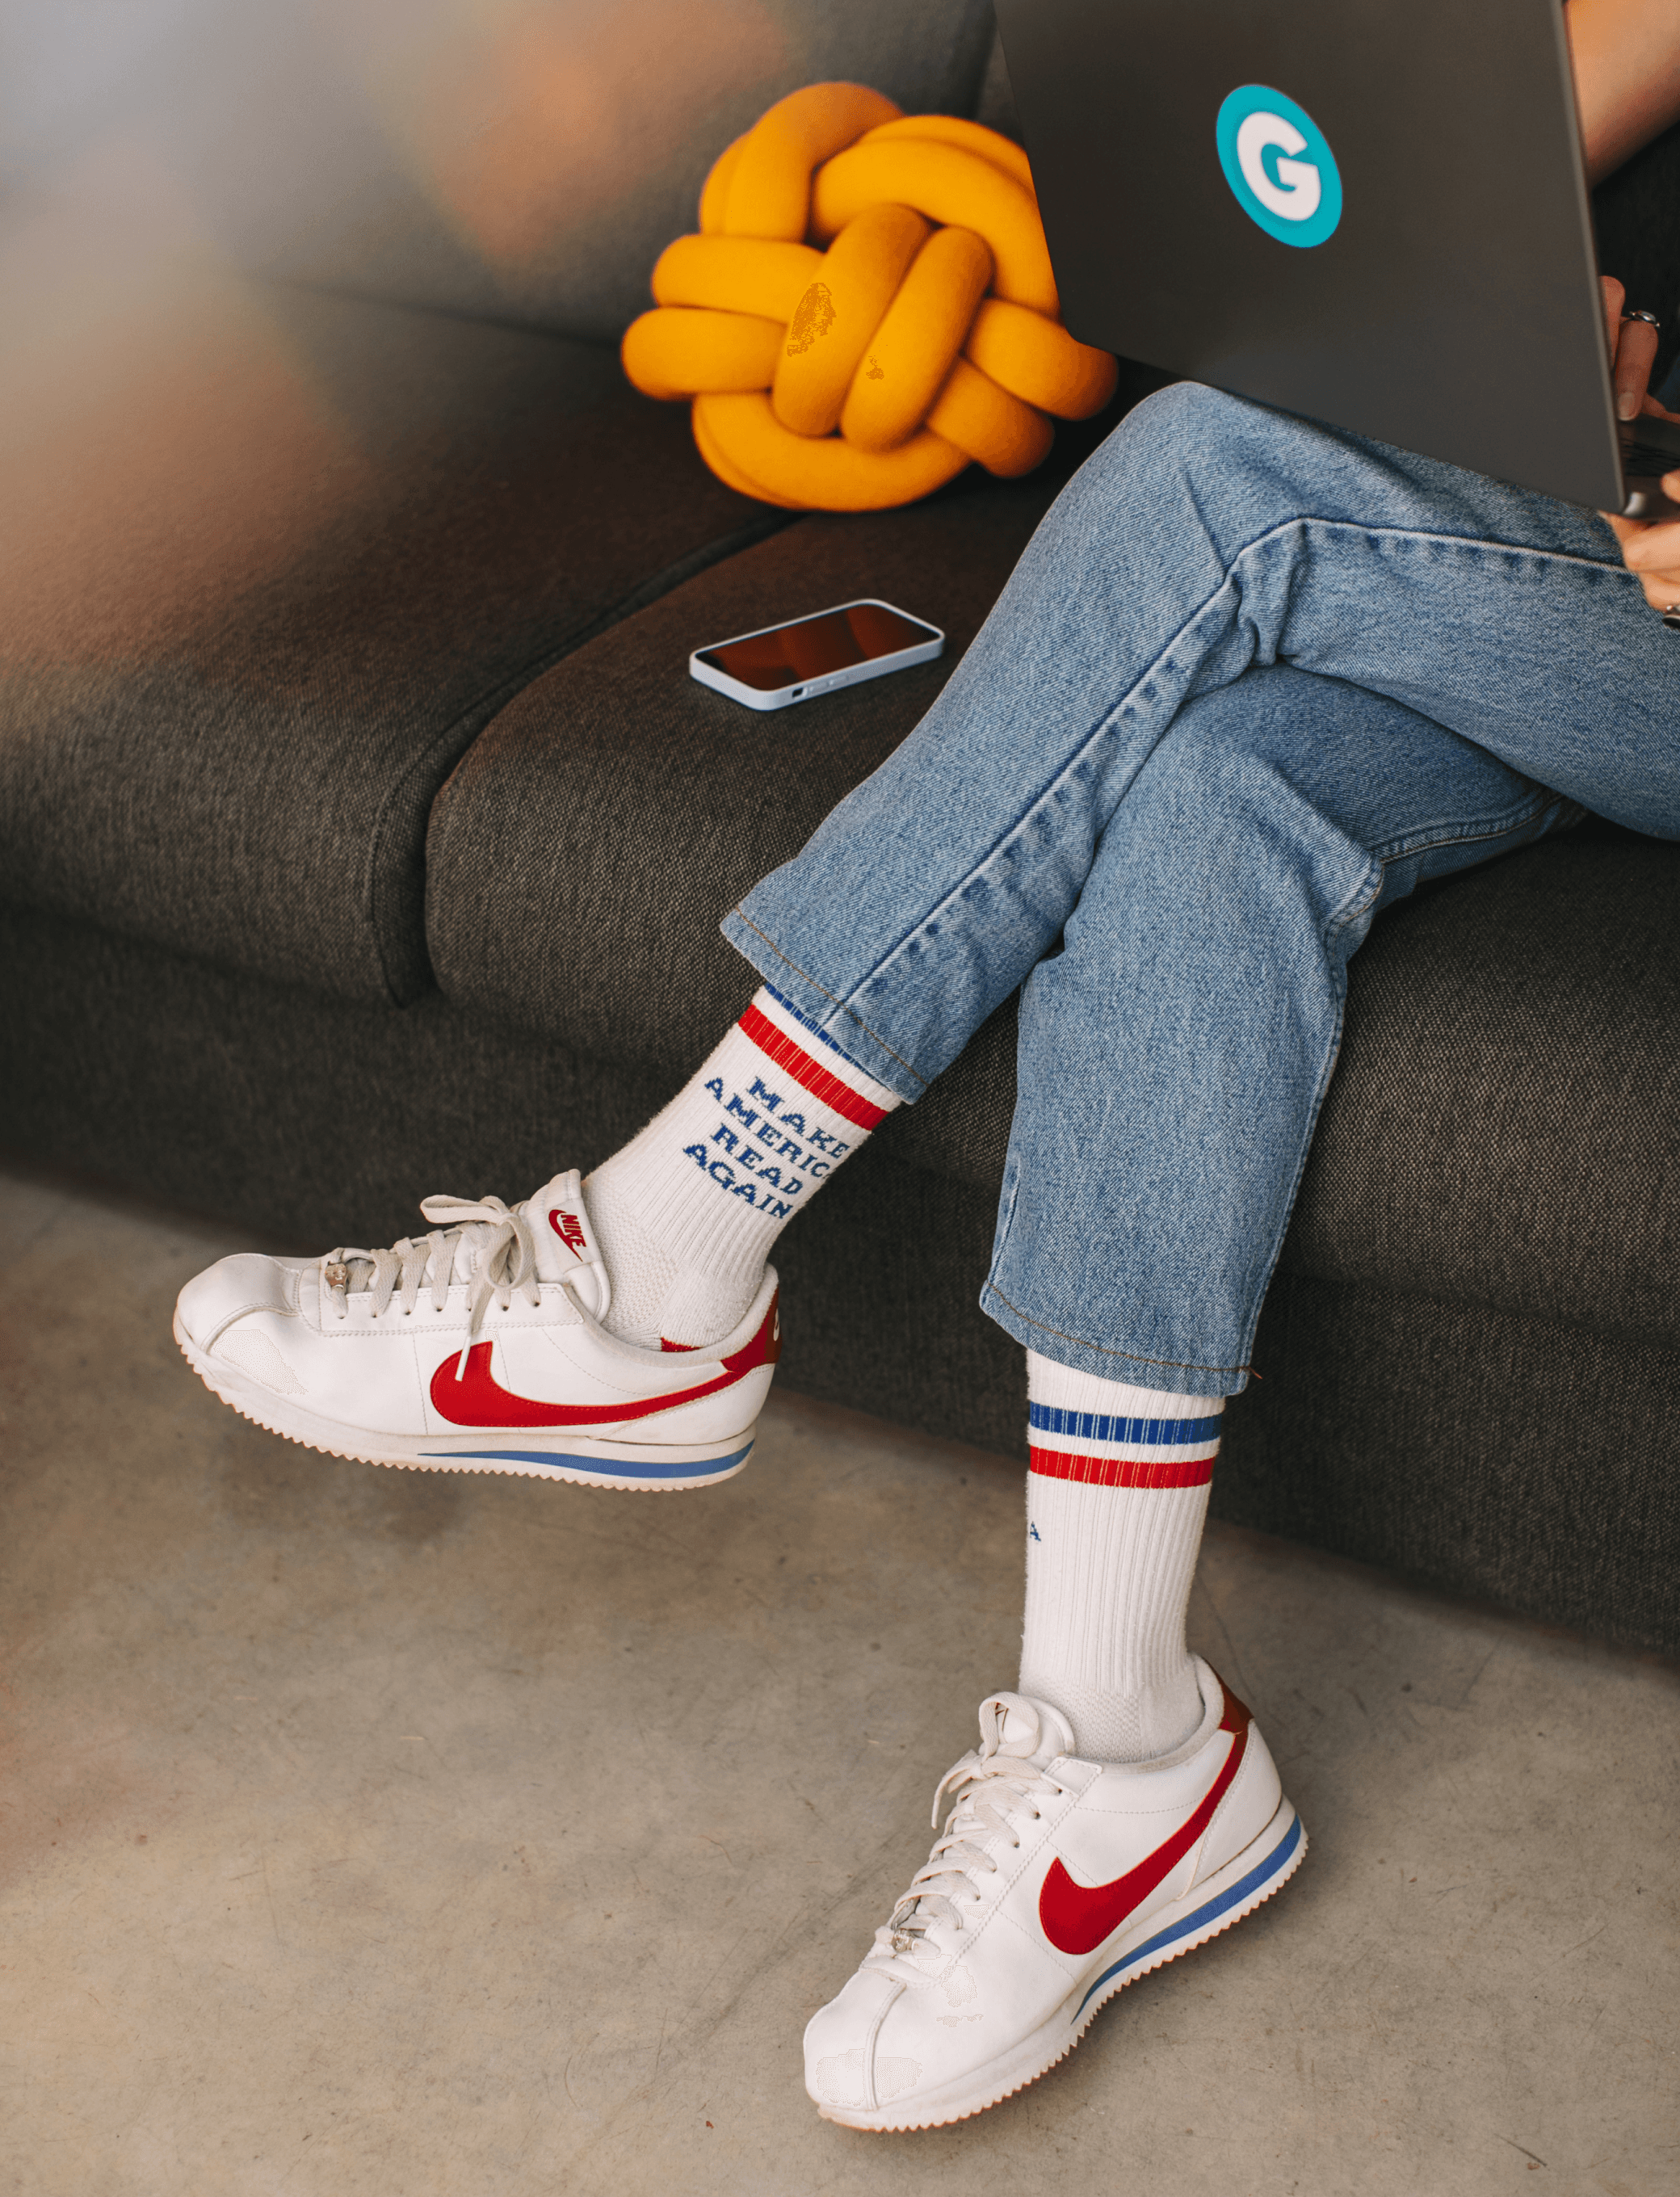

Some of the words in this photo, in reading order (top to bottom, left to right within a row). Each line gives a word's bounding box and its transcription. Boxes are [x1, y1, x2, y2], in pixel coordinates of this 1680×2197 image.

[1237, 111, 1321, 221] G
[704, 1077, 832, 1178] AMERIC
[746, 1076, 850, 1159] MAKE
[682, 1144, 794, 1220] AGAIN
[710, 1123, 804, 1195] READ
[560, 1214, 587, 1248] NIKE
